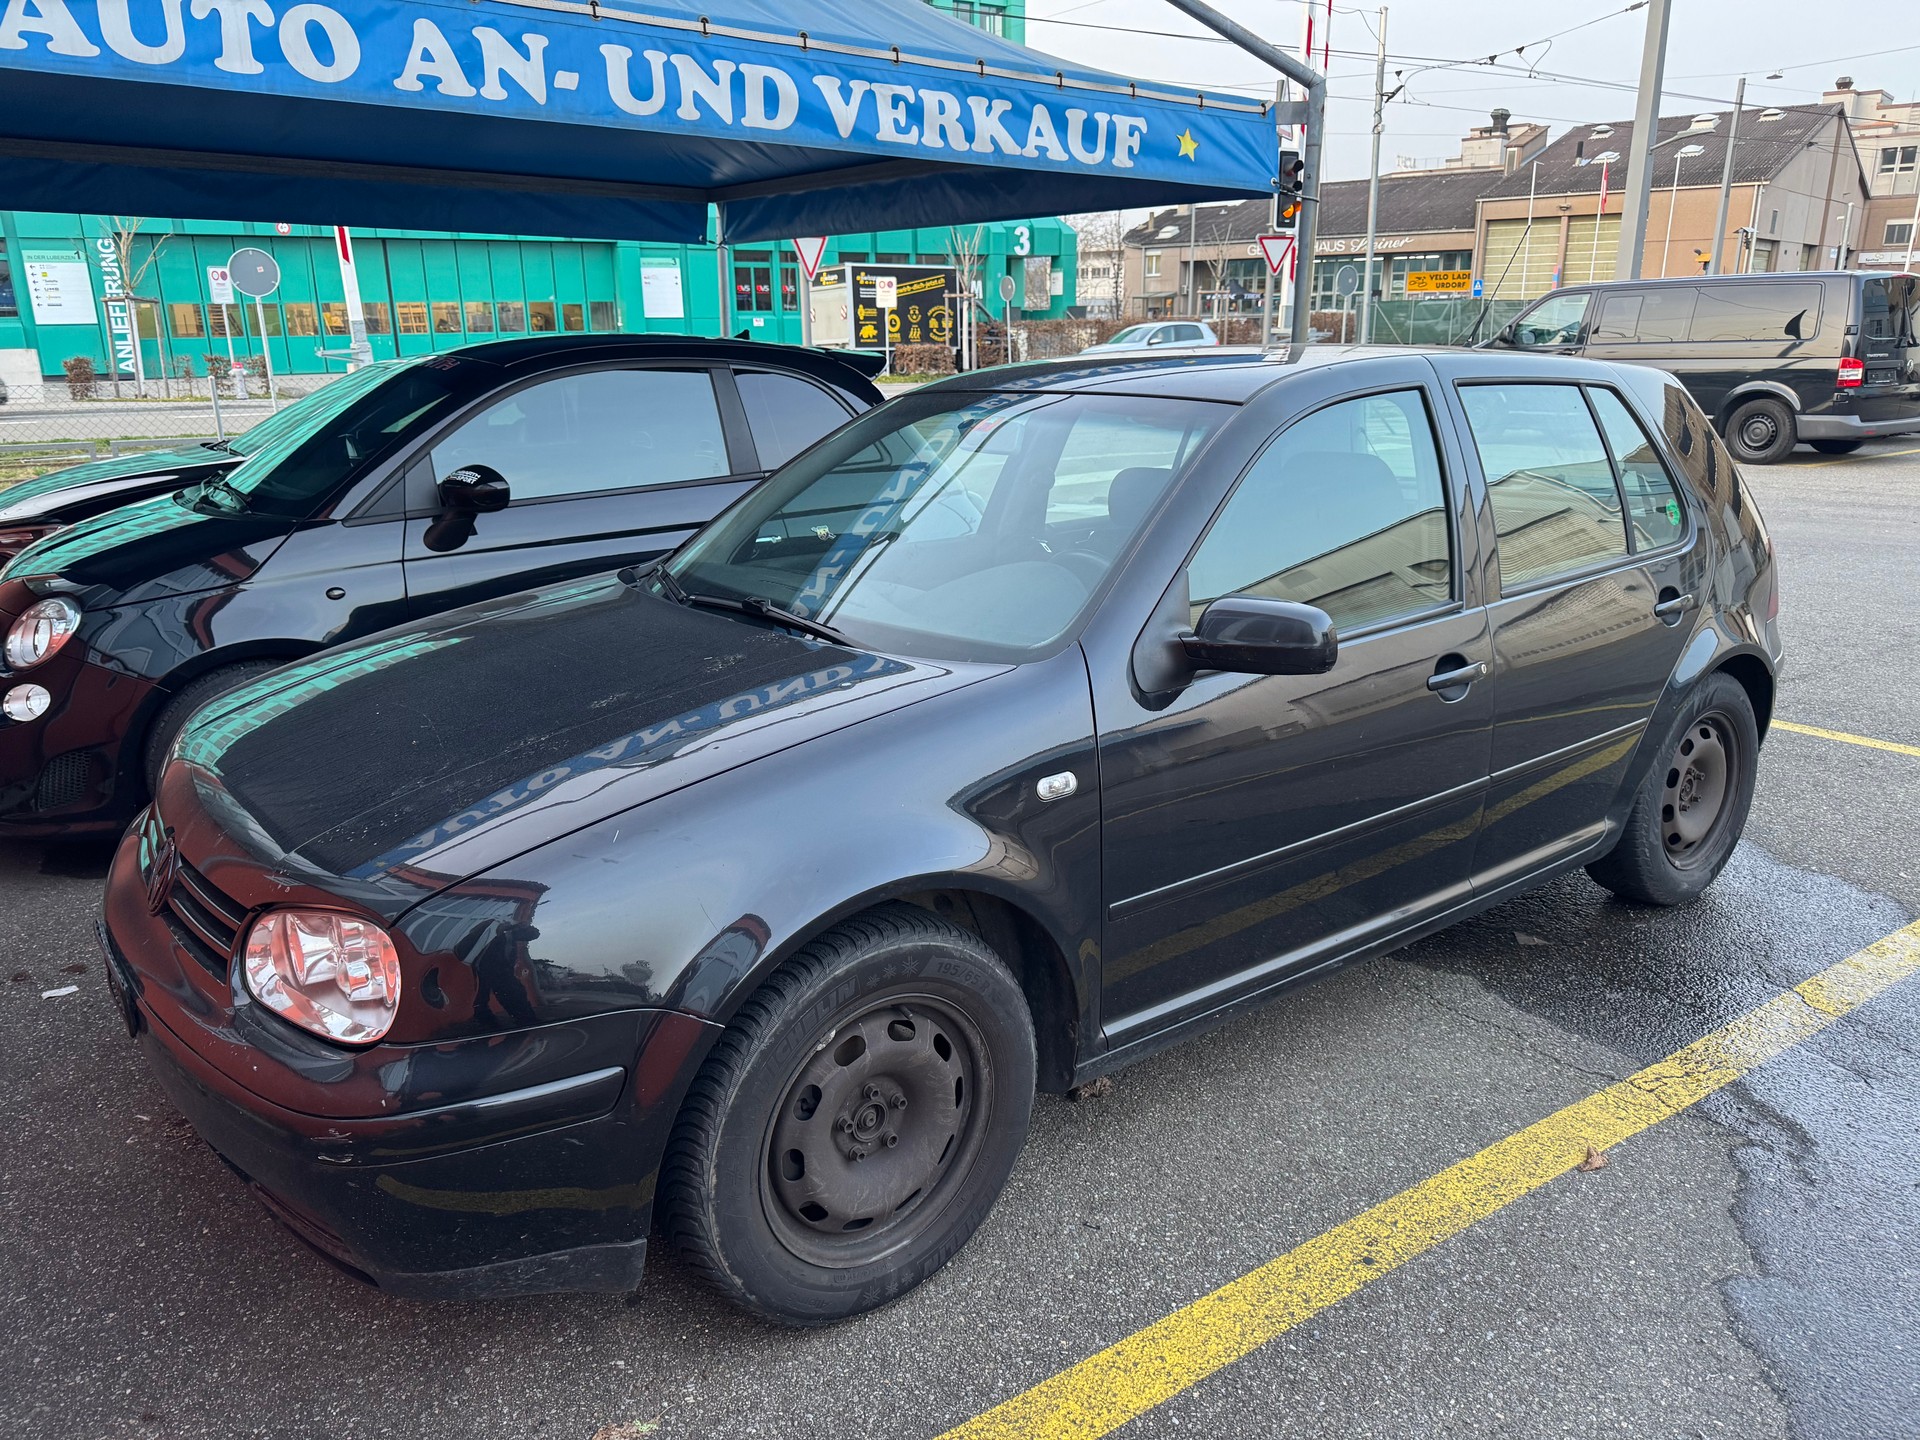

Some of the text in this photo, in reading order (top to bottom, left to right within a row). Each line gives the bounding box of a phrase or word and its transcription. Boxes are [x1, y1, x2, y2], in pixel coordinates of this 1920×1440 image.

[0, 0, 1148, 168] AUTO AN- UND VERKAUF
[1013, 226, 1030, 256] 3
[1350, 236, 1415, 253] Seiner
[74, 250, 81, 260] 1
[936, 962, 982, 986] 195/65
